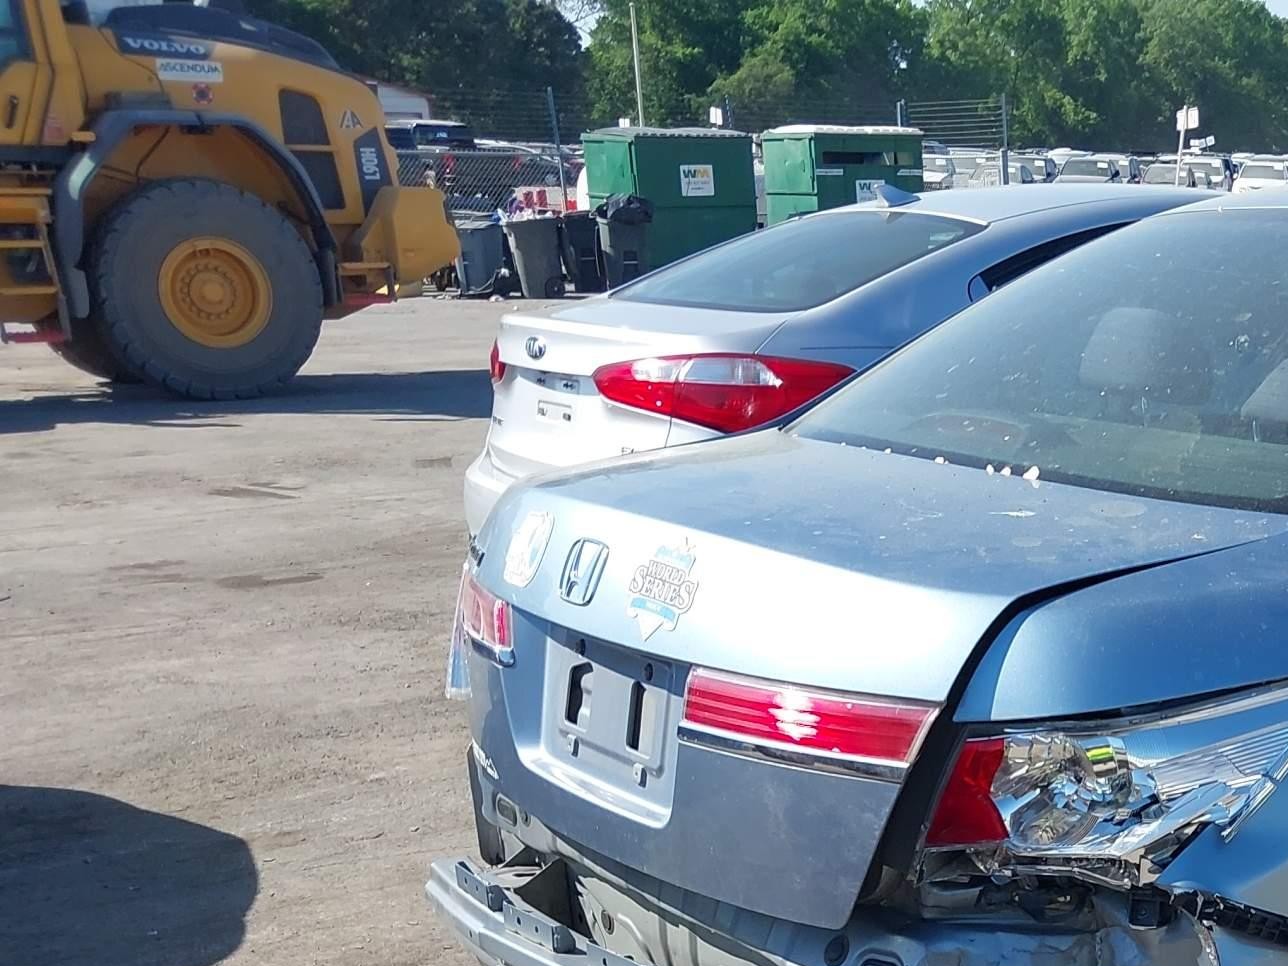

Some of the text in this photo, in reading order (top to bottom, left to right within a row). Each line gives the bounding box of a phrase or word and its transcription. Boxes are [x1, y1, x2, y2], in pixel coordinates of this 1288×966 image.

[122, 37, 206, 55] VOLVO
[359, 147, 381, 180] L90H
[629, 565, 695, 609] SERIES
[647, 559, 687, 586] WORLD
